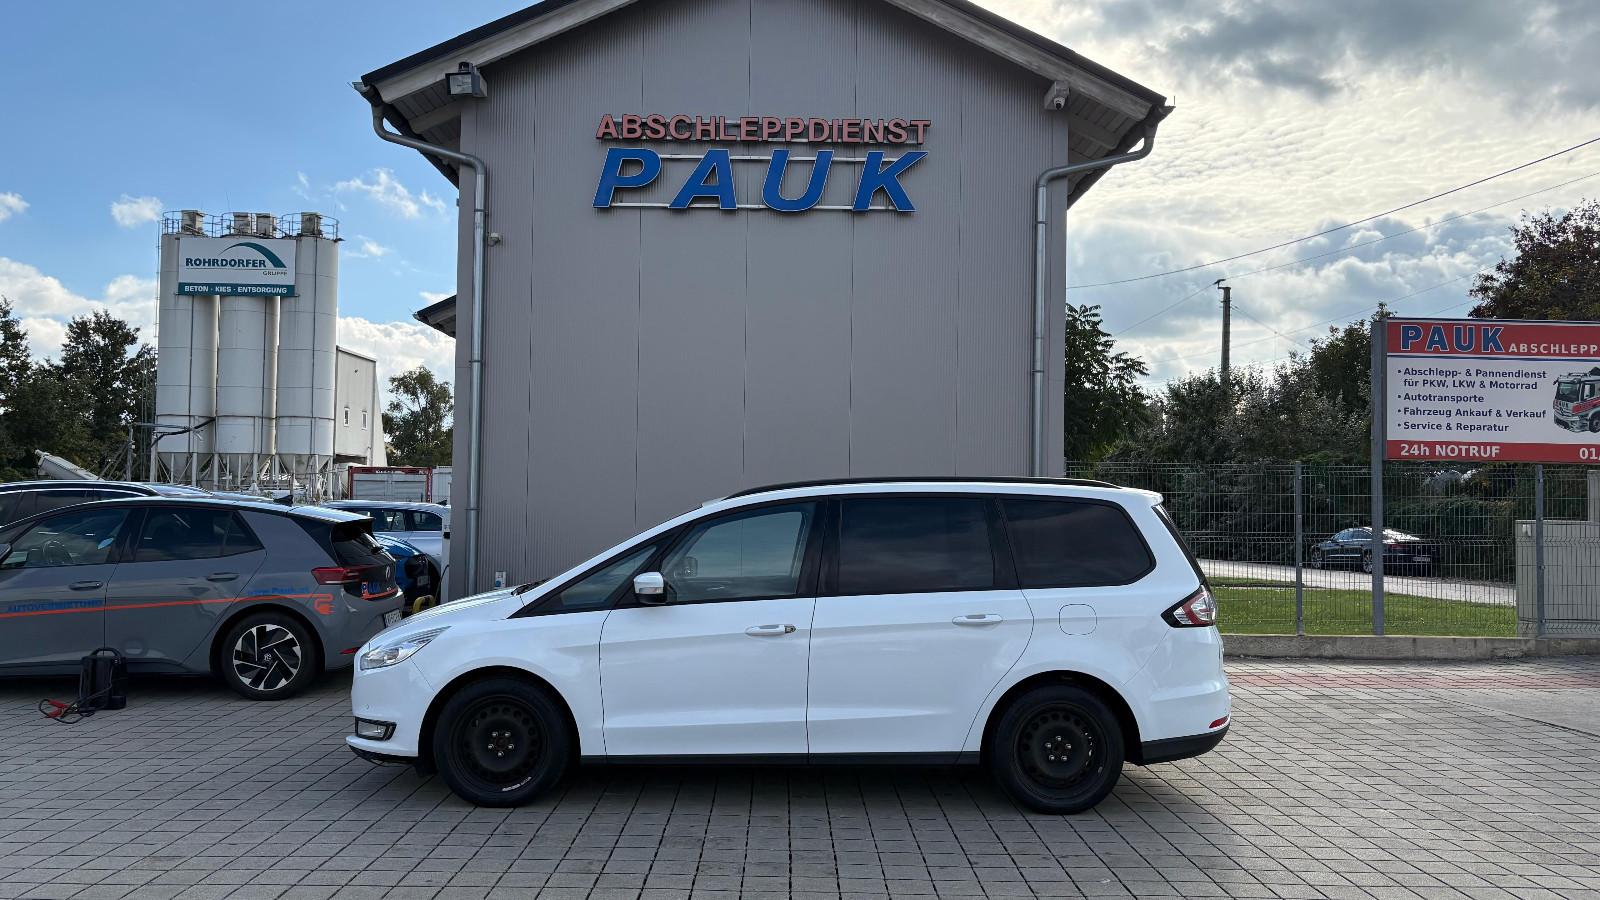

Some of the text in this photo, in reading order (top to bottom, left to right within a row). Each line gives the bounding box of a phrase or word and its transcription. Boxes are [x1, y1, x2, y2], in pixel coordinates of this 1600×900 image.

[596, 114, 931, 145] ABSCHLEPPDIENST
[592, 147, 929, 212] PAUK
[185, 257, 266, 268] ROHRDORFER
[184, 285, 287, 294] BETON KIES ENTSORGUNG
[1400, 325, 1598, 354] PAUK ABSCHLEPP
[1403, 367, 1547, 379] Abschlepp- & Pannendienst
[1403, 378, 1538, 390] für PKW, LKW & Motorrad
[1403, 394, 1484, 404] Autotransporte
[1403, 407, 1547, 419] Fahrzeug Ankauf & Verkauf
[1403, 421, 1509, 433] Service & Reparatur
[1400, 443, 1600, 461] 24h NOTRUF 01
